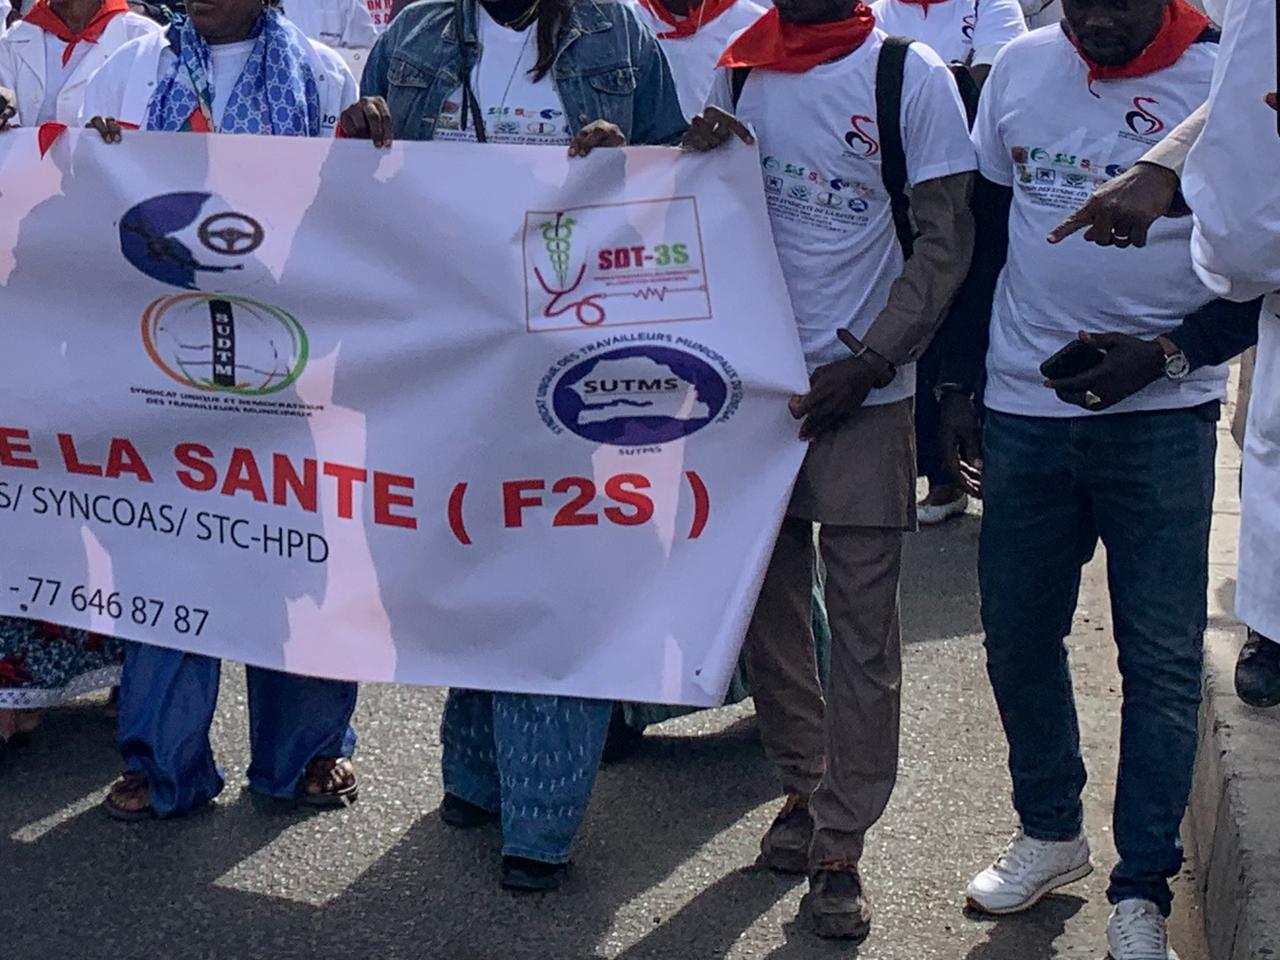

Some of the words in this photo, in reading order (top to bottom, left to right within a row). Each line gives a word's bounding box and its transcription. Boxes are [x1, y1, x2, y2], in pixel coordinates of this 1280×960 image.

[598, 243, 689, 270] SDT-3S
[214, 313, 233, 377] SUDTM
[579, 331, 673, 355] TRAVAILLEURS
[675, 335, 739, 380] MUNICIPAUX
[146, 397, 165, 406] DES
[583, 378, 679, 394] SUTMS
[618, 446, 663, 456] SUTMS
[57, 432, 154, 483] LA
[174, 442, 417, 530] SANTE
[448, 482, 472, 545] (
[502, 472, 654, 528] F2S
[685, 470, 710, 540] )
[32, 486, 188, 537] SYNCOAS/
[196, 511, 329, 564] STC-HPD
[28, 577, 62, 606] 77
[71, 585, 123, 619] 646
[131, 596, 165, 627] 87
[174, 605, 209, 636] 87
